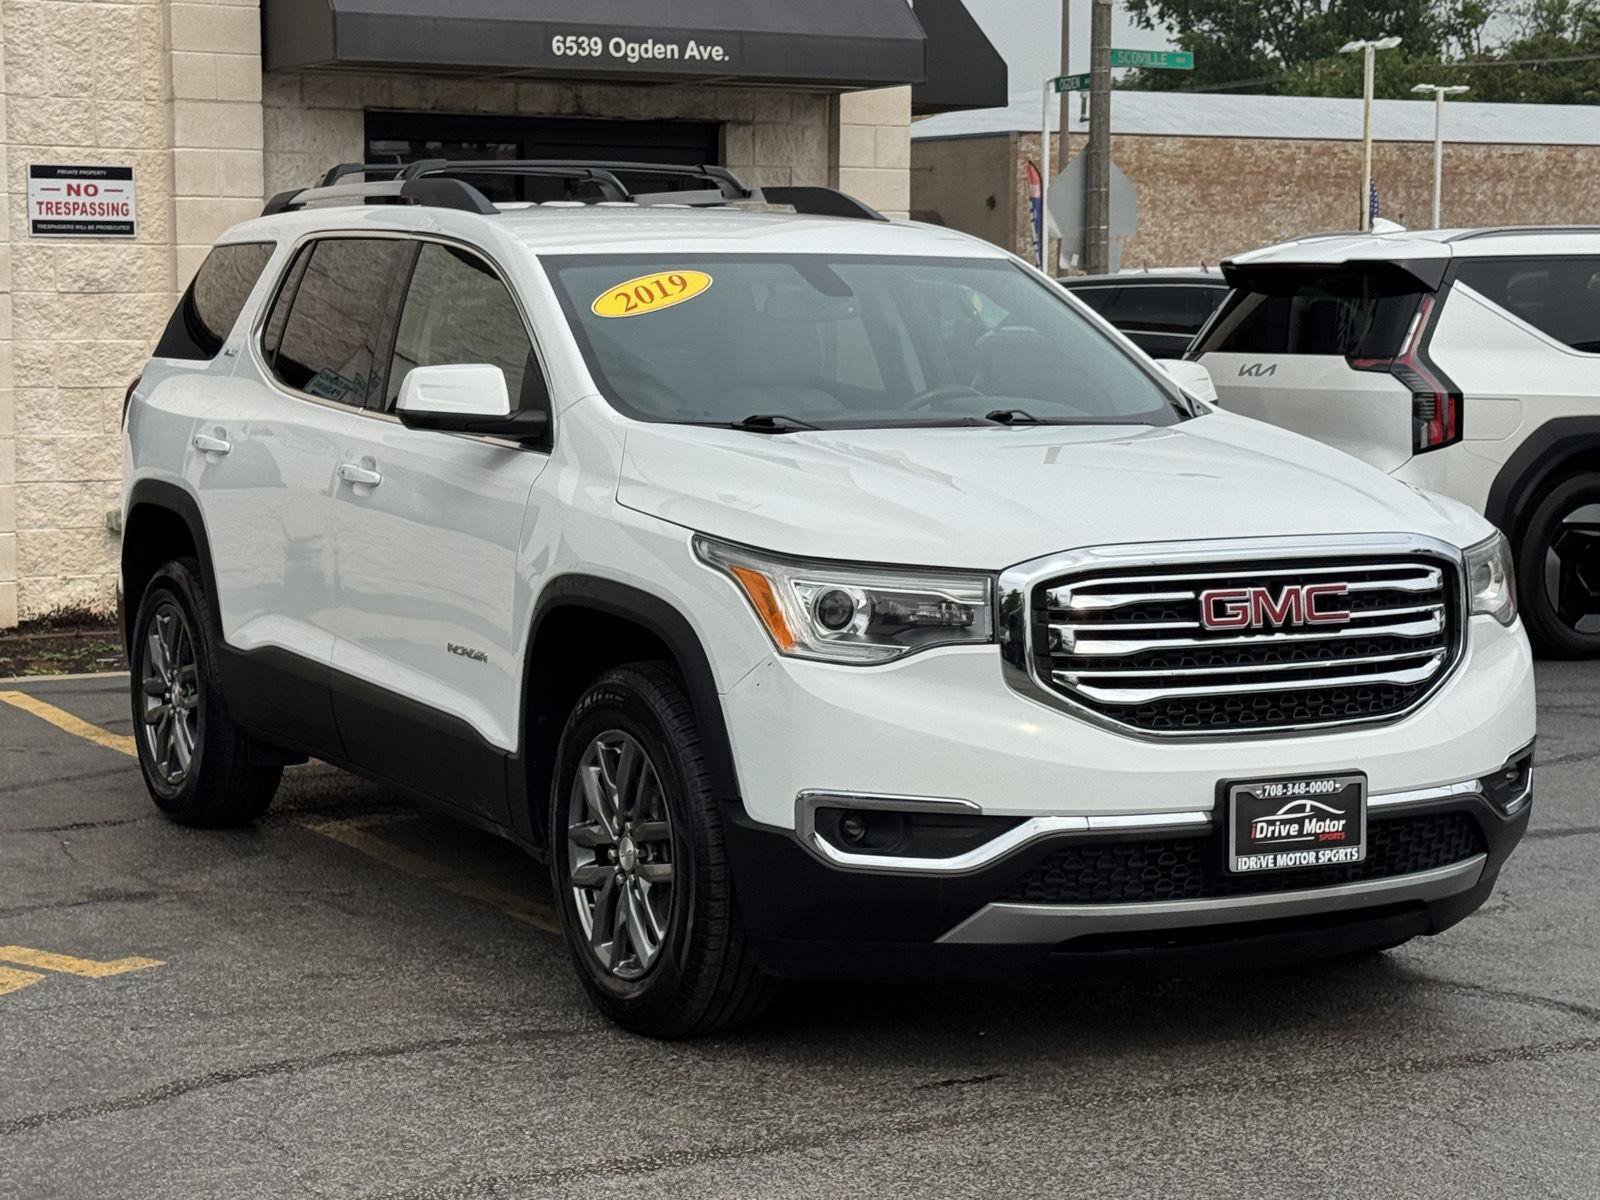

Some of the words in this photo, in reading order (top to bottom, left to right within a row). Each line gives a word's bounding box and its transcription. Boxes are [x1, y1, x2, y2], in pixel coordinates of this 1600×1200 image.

[552, 35, 603, 57] 6539
[608, 37, 679, 63] Ogden
[683, 40, 730, 61] Ave.
[1117, 51, 1168, 65] SCOVILLE
[66, 183, 99, 197] NO
[36, 201, 129, 217] TRESPASSING
[614, 274, 688, 312] 2019
[1200, 582, 1350, 630] GMC
[1263, 780, 1335, 797] 708-348-0000
[1251, 821, 1299, 839] iDrive
[1303, 818, 1346, 834] Motor
[1318, 832, 1345, 842] SPORTS
[1276, 852, 1317, 867] MOTOR
[1318, 848, 1359, 864] SPORTS
